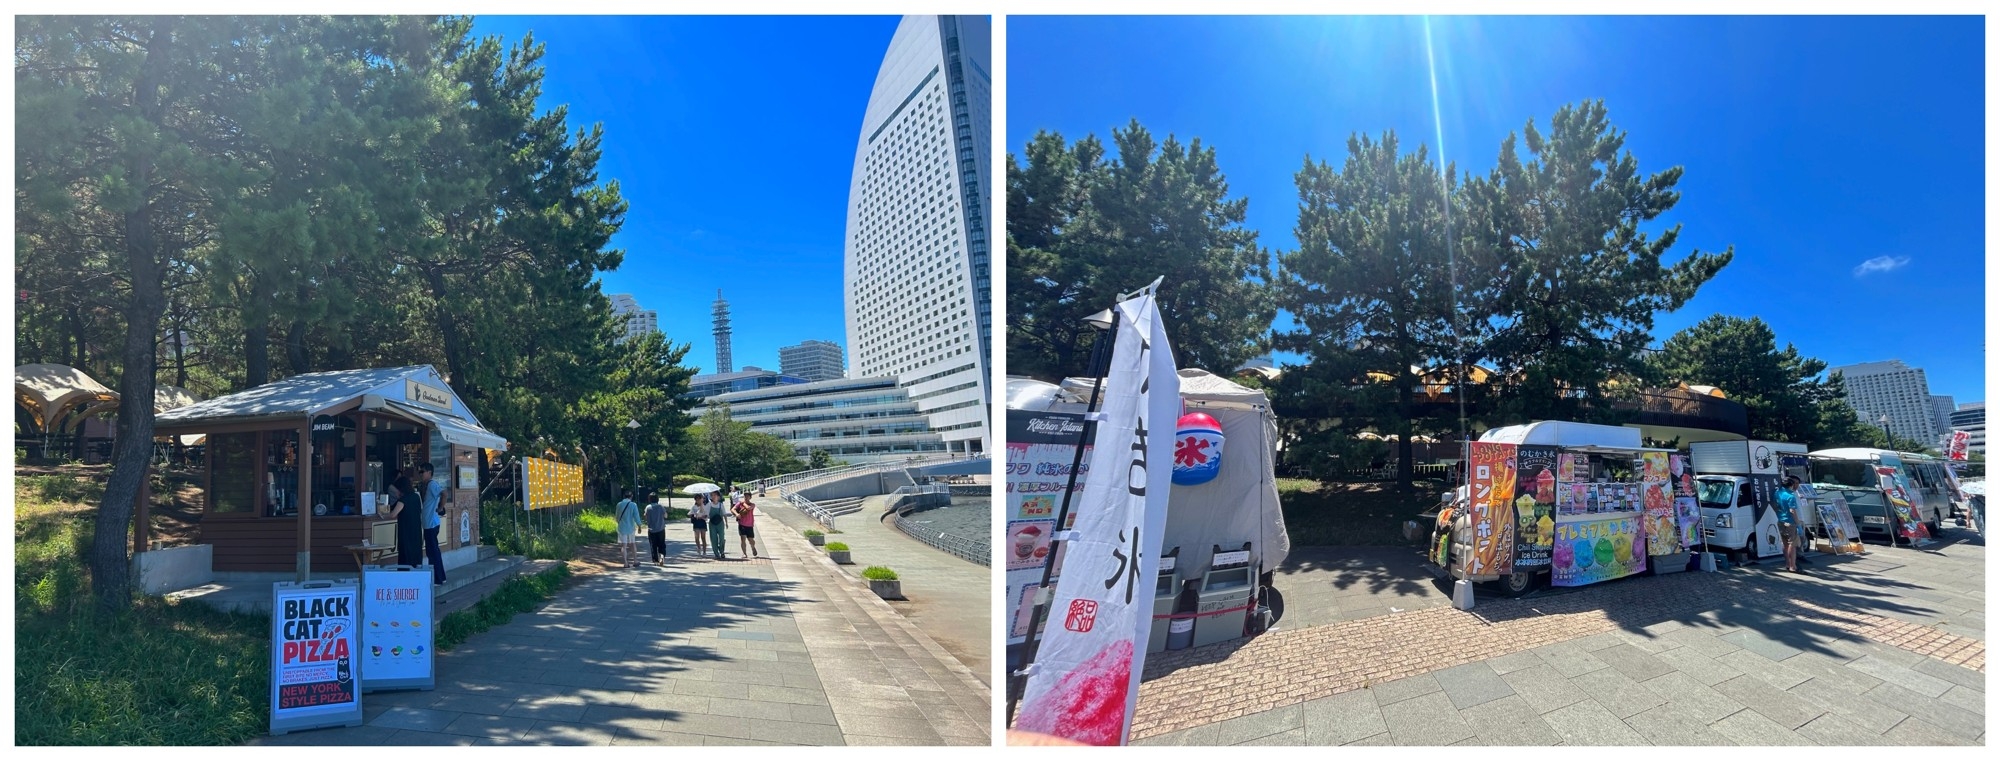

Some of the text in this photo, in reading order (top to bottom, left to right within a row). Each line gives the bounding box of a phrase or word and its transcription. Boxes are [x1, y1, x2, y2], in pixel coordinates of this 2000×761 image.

[1026, 418, 1059, 432] Kitchen
[1174, 437, 1210, 467] 氷
[1473, 465, 1492, 575] ロングポテト
[394, 588, 419, 600] SHERBET
[284, 597, 349, 620] BLACK
[283, 619, 322, 641] CAT
[283, 638, 350, 665] PIZZA
[282, 683, 342, 697] NEW YORK
[282, 692, 352, 707] STYLE PIZZA
